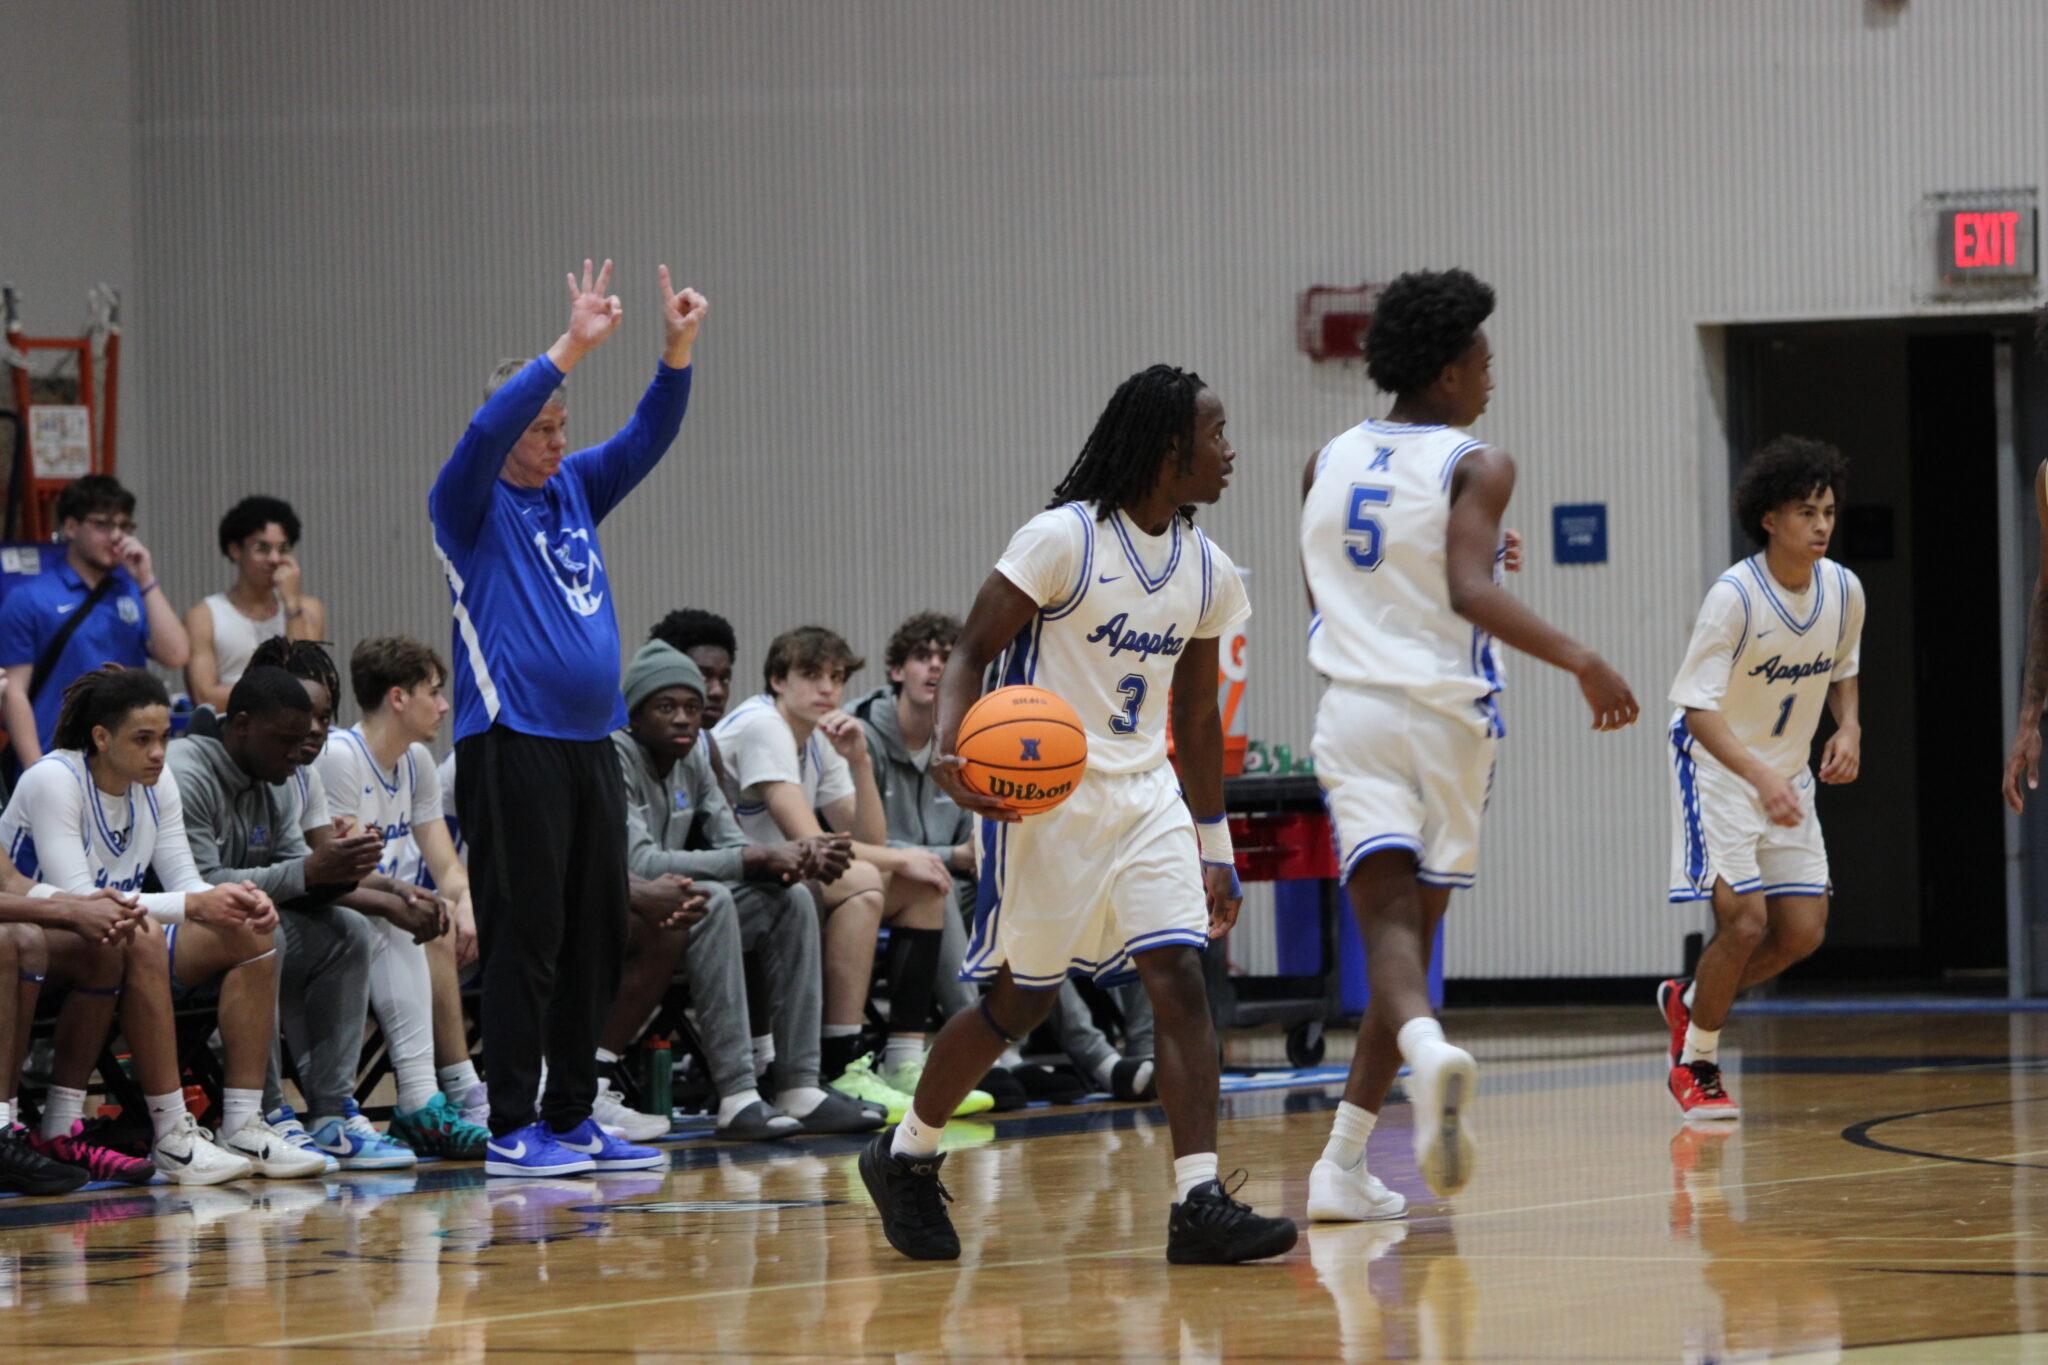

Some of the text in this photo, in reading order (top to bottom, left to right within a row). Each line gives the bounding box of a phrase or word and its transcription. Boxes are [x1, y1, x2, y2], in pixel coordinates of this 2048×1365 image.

[1954, 211, 2019, 267] EXIT
[1343, 482, 1395, 573] 5
[1087, 612, 1184, 662] Apopka
[1748, 651, 1832, 685] Apopka
[1108, 673, 1148, 735] 3
[1770, 693, 1797, 738] 1
[989, 775, 1072, 800] Wilson
